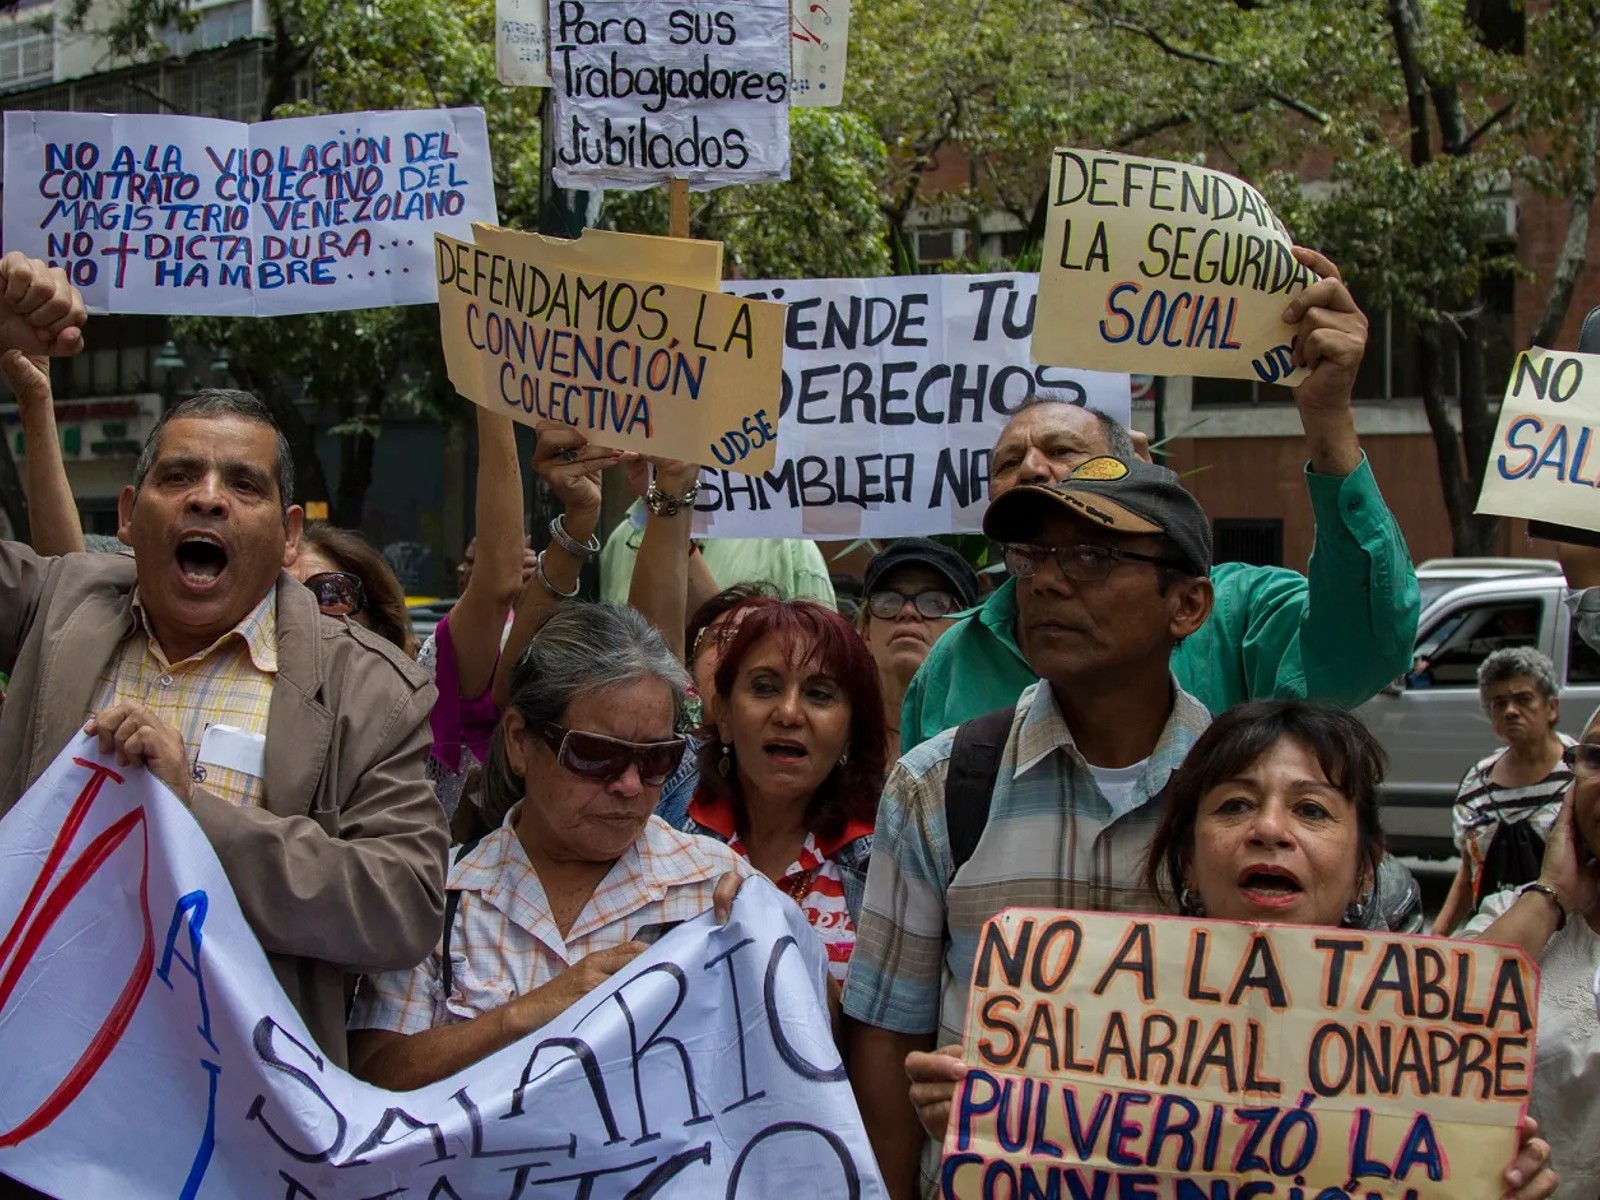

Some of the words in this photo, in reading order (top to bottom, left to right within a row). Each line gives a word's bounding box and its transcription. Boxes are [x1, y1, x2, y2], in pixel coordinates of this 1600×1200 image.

[559, 0, 646, 45] Para
[556, 45, 787, 113] Trabajadores
[45, 142, 99, 172] NO
[404, 131, 459, 163] DEL
[559, 115, 749, 169] Jubilados
[39, 171, 199, 201] CONTRATO
[215, 165, 383, 202] COLECTIVO
[400, 163, 468, 191] DEL
[40, 200, 249, 231] MAGISTERIO
[262, 190, 465, 231] VENEZOLANO
[48, 231, 93, 257] NO
[1060, 219, 1110, 272] LA
[435, 237, 669, 341] DEFENDAMOS
[693, 294, 753, 359] LA
[1099, 281, 1242, 349] SOCIAL
[467, 302, 707, 400] CONVENCIÓN
[1251, 334, 1298, 383] UD
[1513, 353, 1583, 403] NO
[500, 362, 653, 439] COLECTIVA
[710, 408, 777, 466] UDSE
[1497, 414, 1600, 490] SAL
[973, 918, 1083, 994] NO
[1092, 922, 1156, 1002] A
[1188, 930, 1292, 1010] LA
[1314, 937, 1534, 1033] TABLA
[976, 994, 1282, 1097] SALARIAL
[1307, 1022, 1531, 1100] ONAPRE
[956, 1069, 1318, 1178] PULVERIZÓ
[1349, 1106, 1447, 1183] LA
